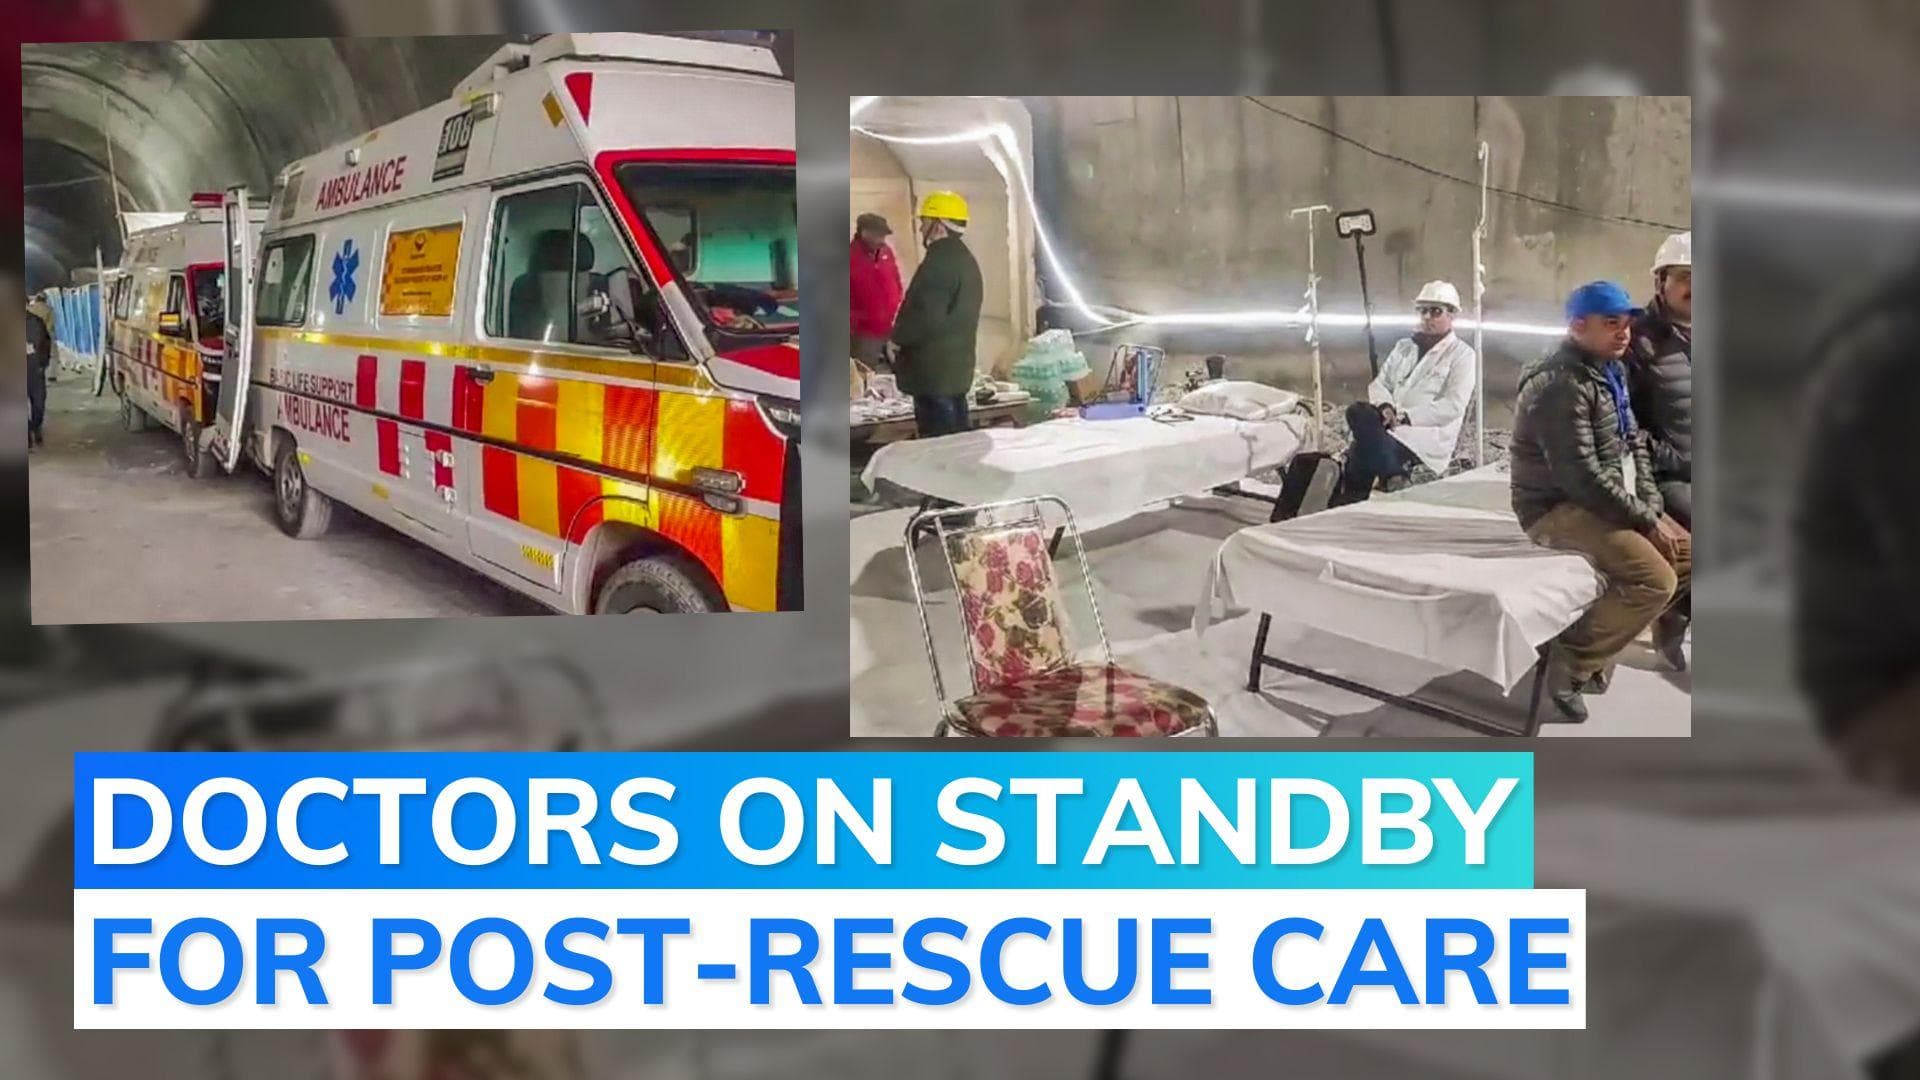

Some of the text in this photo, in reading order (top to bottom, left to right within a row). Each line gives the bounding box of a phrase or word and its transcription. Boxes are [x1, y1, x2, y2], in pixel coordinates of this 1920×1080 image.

[443, 112, 474, 151] 108
[315, 155, 407, 212] AMBULANCE
[310, 374, 354, 404] SUPPORT
